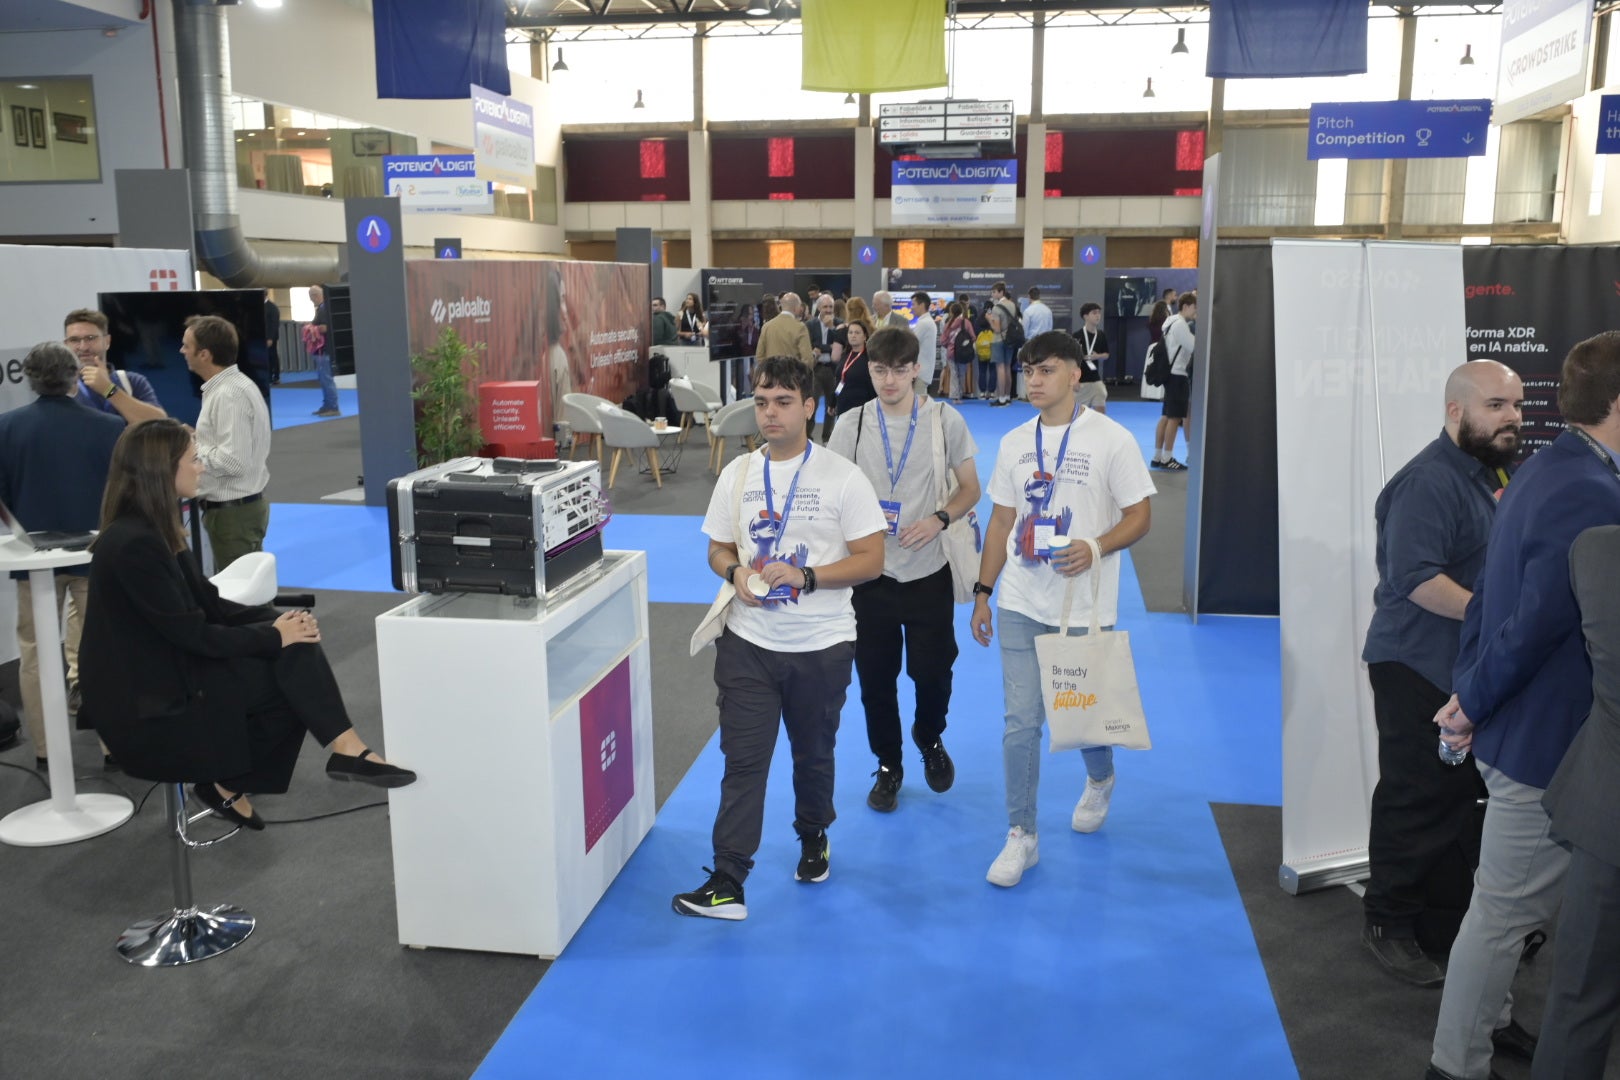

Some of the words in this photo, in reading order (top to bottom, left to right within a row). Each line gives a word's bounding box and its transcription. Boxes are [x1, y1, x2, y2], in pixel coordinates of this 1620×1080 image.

[1510, 29, 1577, 76] CROWDSTRIKE
[1607, 109, 1620, 122] H
[1317, 116, 1354, 129] Pitch
[1316, 132, 1405, 147] Competition
[897, 163, 1011, 180] POTENCIALDIGITAL
[981, 195, 991, 203] EY
[1465, 283, 1516, 299] gente.
[448, 296, 491, 323] paloalto
[591, 330, 616, 346] Automate
[1507, 327, 1536, 338] XDR
[1469, 343, 1486, 352] en
[1488, 341, 1502, 352] IA
[1504, 341, 1549, 352] nativa.
[591, 352, 613, 368] Unleash
[1066, 449, 1092, 458] Conoce
[1063, 456, 1091, 466] resente,
[1066, 468, 1089, 477] Futuro
[791, 492, 821, 500] resente,
[1052, 664, 1062, 676] Be
[1063, 667, 1088, 679] ready
[1052, 679, 1063, 690] for
[1064, 681, 1077, 691] the
[1053, 690, 1098, 711] future
